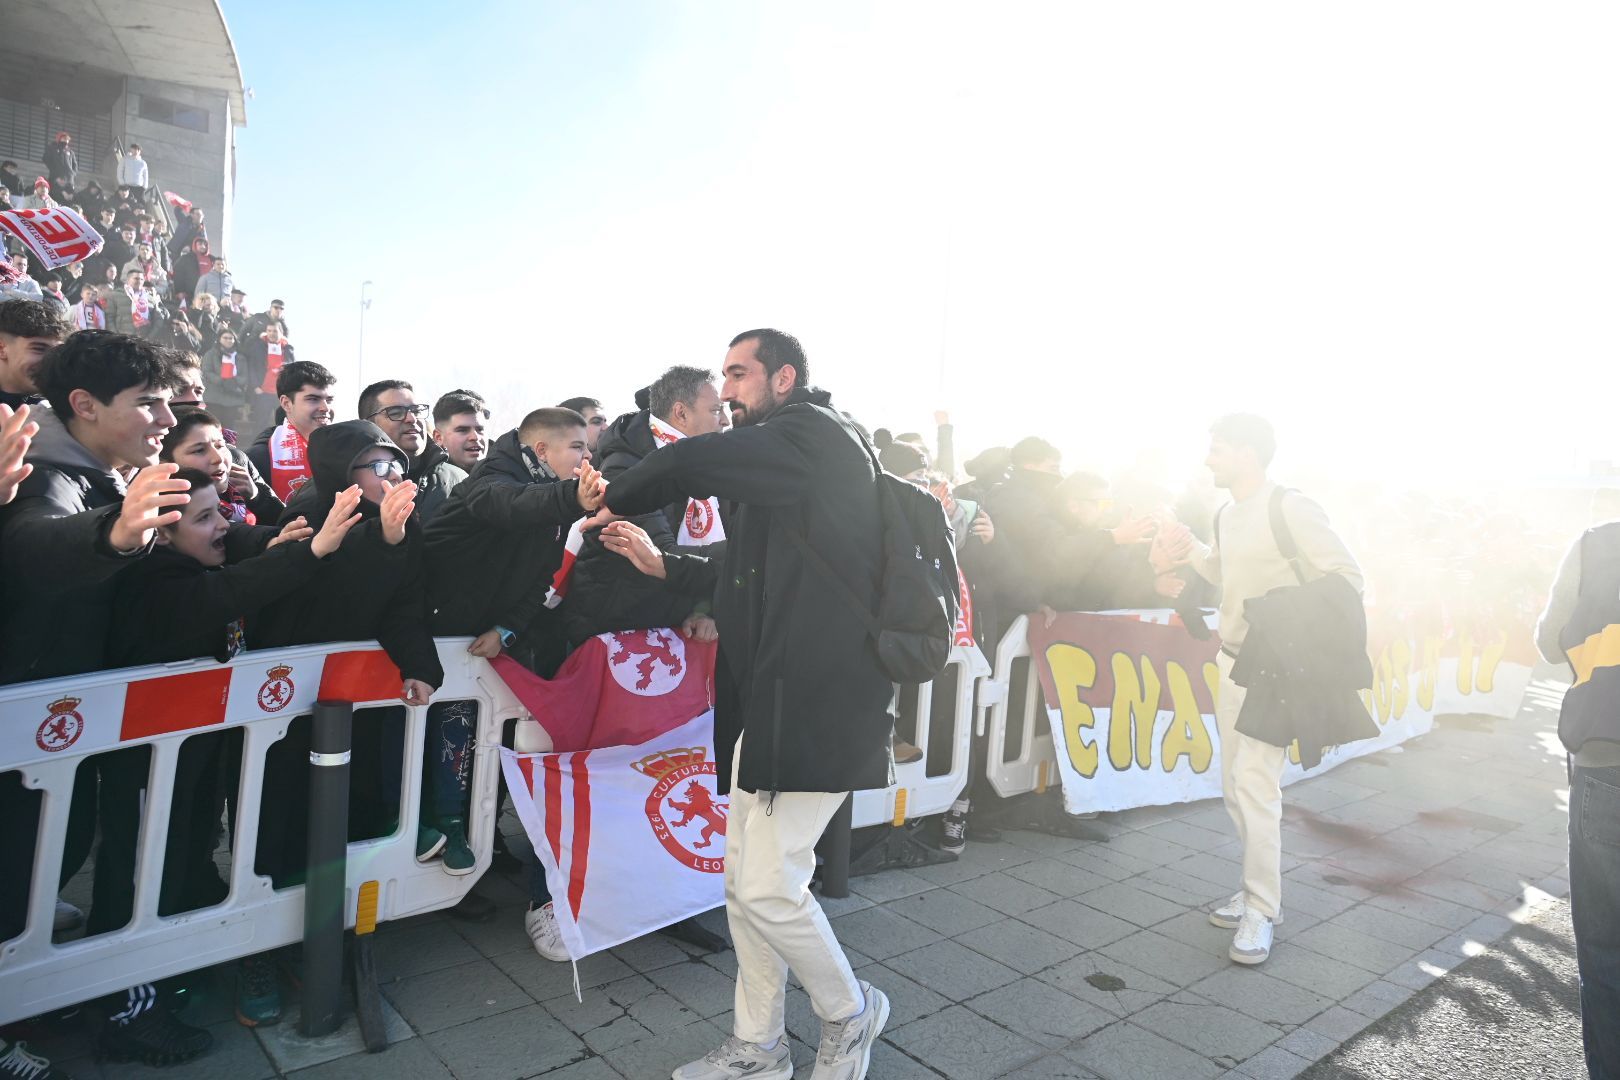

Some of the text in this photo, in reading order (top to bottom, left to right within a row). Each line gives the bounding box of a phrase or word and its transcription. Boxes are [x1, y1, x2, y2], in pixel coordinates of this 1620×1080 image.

[20, 218, 58, 261] DEPORTIVA
[1045, 641, 1222, 780] ENA
[652, 763, 717, 800] CULTURAL
[650, 812, 670, 841] 1923
[693, 857, 725, 871] LEO
